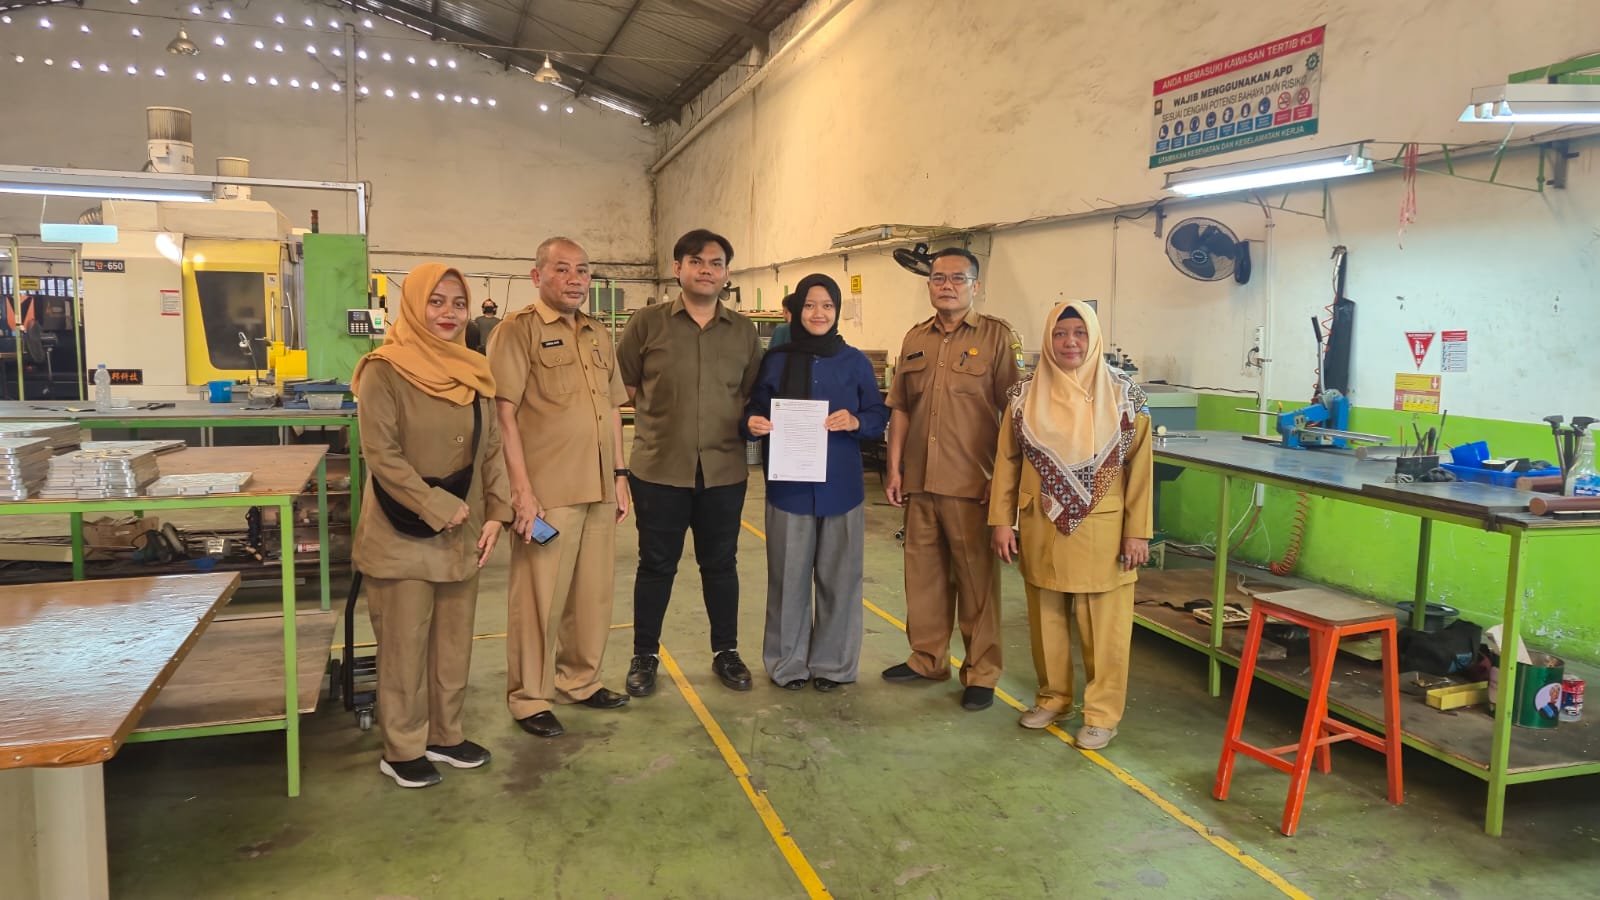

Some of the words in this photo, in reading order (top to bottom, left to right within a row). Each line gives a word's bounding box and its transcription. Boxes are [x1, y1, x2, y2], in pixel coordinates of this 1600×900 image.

[1162, 77, 1182, 89] ANDA
[1183, 64, 1223, 83] MEMASUKI
[1224, 49, 1265, 70] KAWASAN
[1267, 39, 1298, 55] TERTIB
[1300, 34, 1313, 46] K3
[1162, 109, 1182, 123] SESUAI
[1183, 101, 1209, 118] DENGAN
[1209, 94, 1238, 111] POTENSI
[1238, 86, 1265, 102] BAHAYA
[1265, 81, 1280, 96] DAN
[1282, 75, 1307, 89] RISIKO
[1173, 92, 1199, 107] WAJIB
[1200, 70, 1271, 97] MENGGUNAKAN
[1273, 65, 1293, 78] APD
[1221, 140, 1234, 150] DAN
[1281, 125, 1305, 138] KERJA
